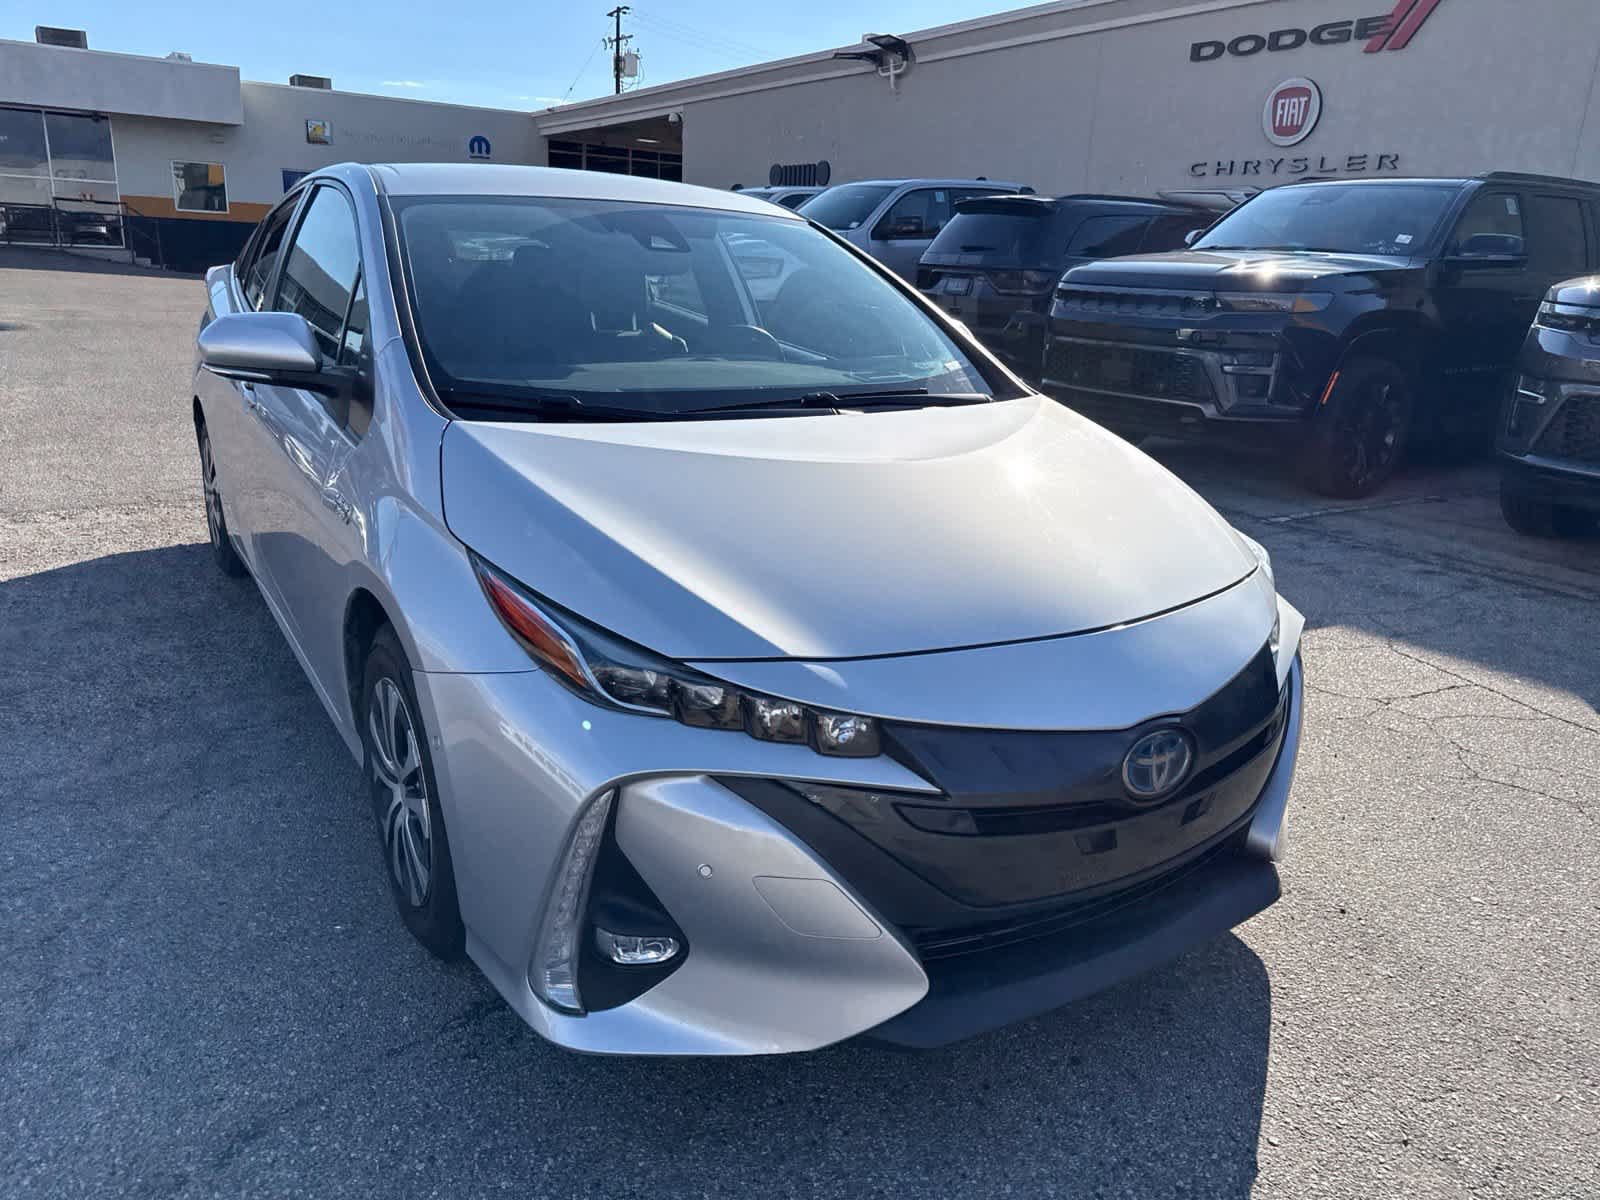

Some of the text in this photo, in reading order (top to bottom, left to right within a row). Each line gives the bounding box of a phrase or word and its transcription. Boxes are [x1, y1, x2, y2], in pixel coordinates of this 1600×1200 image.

[1190, 15, 1394, 62] DODGE
[1275, 96, 1309, 127] FIAT
[1190, 153, 1400, 177] CHRYSLER
